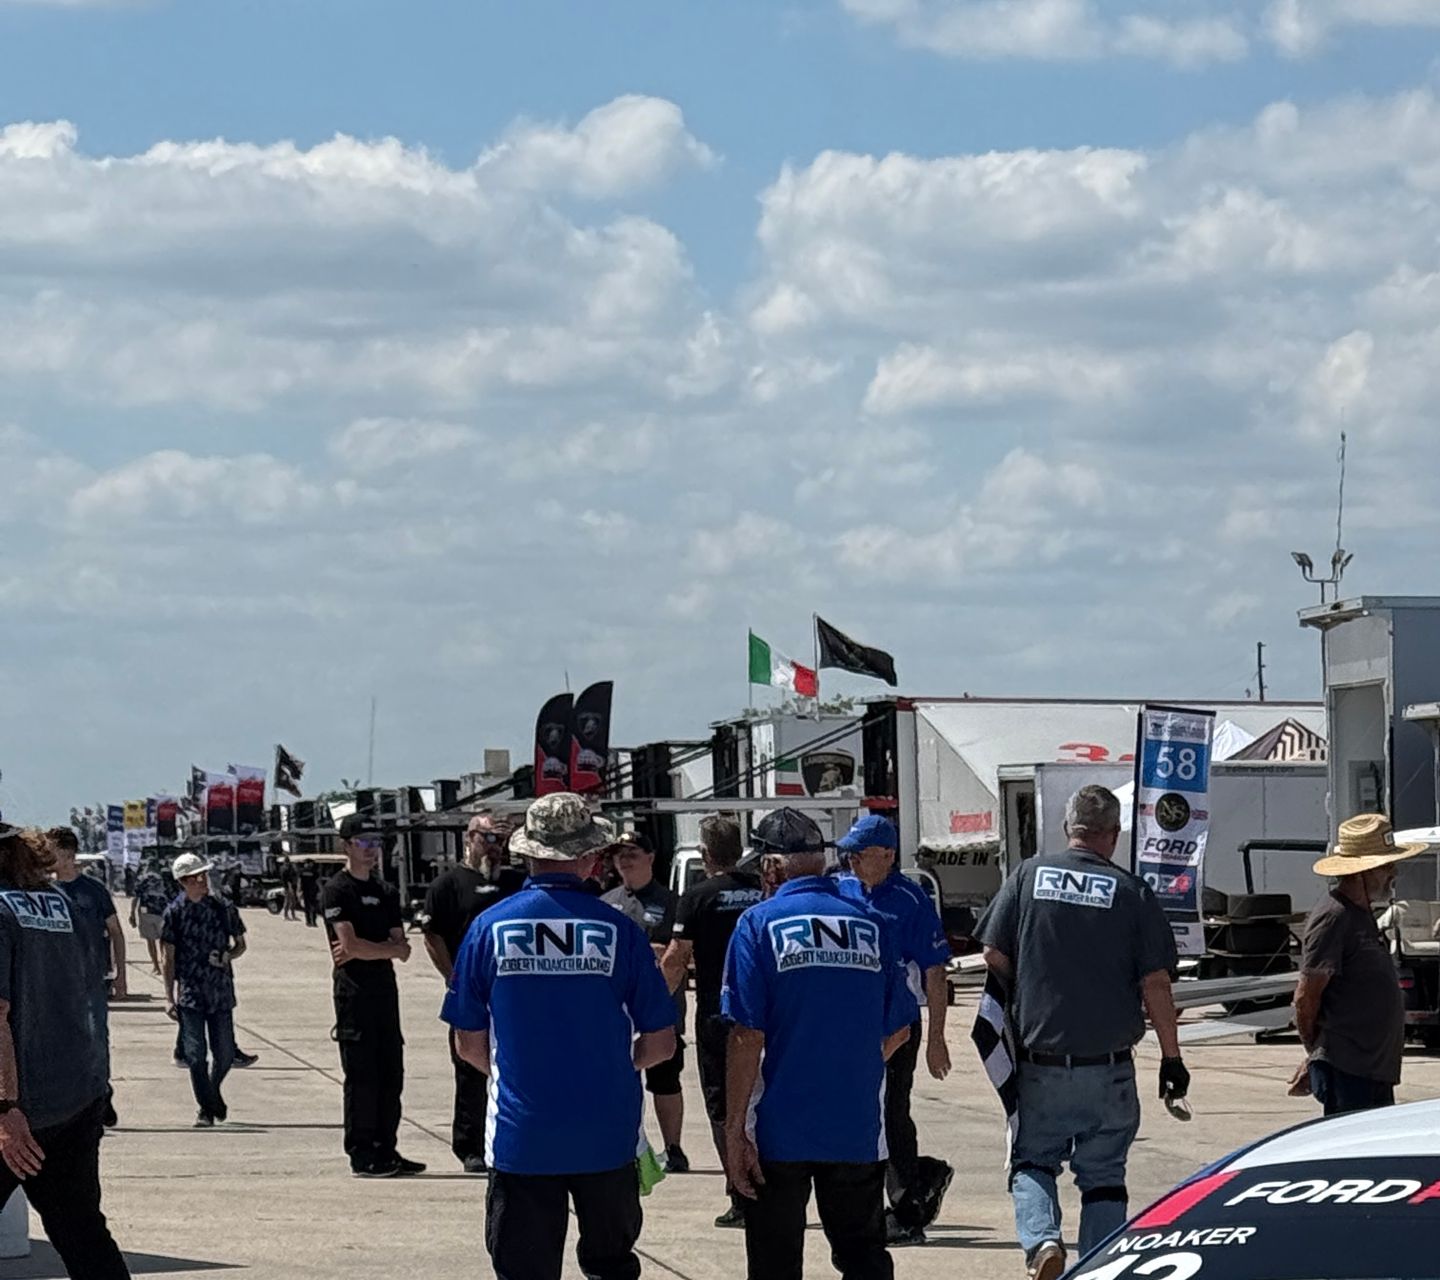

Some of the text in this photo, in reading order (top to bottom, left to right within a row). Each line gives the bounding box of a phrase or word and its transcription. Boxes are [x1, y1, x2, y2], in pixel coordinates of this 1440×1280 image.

[1156, 745, 1198, 781] 58
[934, 851, 989, 866] ADE IN
[1144, 837, 1198, 856] FORD
[1038, 869, 1114, 897] RNR
[6, 892, 69, 919] RNR
[497, 922, 613, 958] RNR
[772, 917, 877, 957] RNR
[1107, 1226, 1258, 1256] NOAKER
